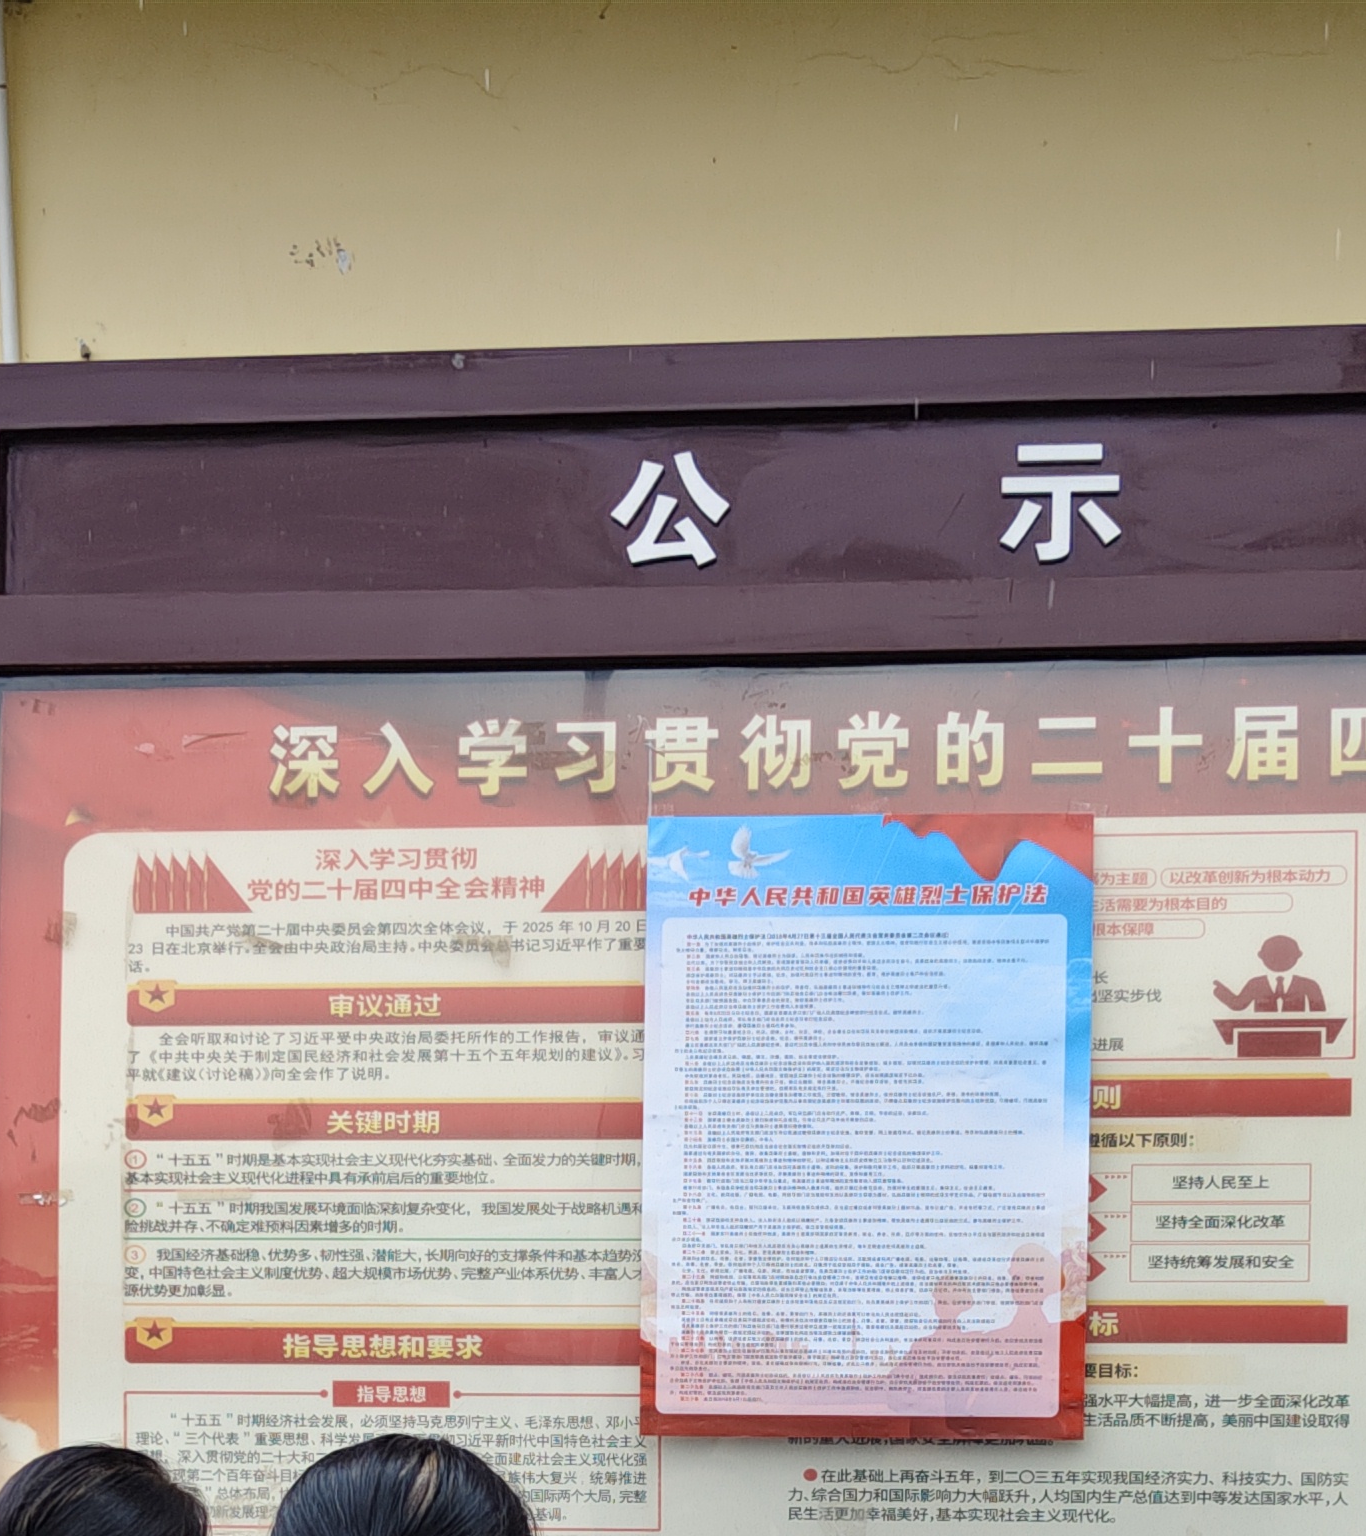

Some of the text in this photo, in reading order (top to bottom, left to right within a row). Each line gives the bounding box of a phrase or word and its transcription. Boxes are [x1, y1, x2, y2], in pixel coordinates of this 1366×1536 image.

[315, 847, 478, 873] 深入学习贯彻
[1170, 868, 1332, 885] 以改革创新为根本动力
[247, 876, 546, 902] 党的二十届四中全会精神
[687, 882, 1049, 909] 中华人民共和国英雄烈士保护法
[127, 958, 151, 975] 话。
[328, 990, 443, 1019] 审议通过
[1092, 1034, 1124, 1052] 进展
[1092, 1083, 1122, 1110] 则
[326, 1109, 441, 1136] 关键时期
[125, 1170, 496, 1187] 基本实现社会主义现代化进程中具有承前启后的重要地位。
[1171, 1174, 1271, 1191] 坚持人民至上
[125, 1219, 404, 1235] 险挑战并存、不确定难预料因素增多的时期。
[1154, 1213, 1287, 1230] 坚持全面深化改革
[1146, 1253, 1296, 1270] 坚持统筹发展和安全
[124, 1283, 232, 1299] 源优势更加彰显。
[1088, 1309, 1120, 1338] 标
[282, 1332, 484, 1361] 指导思想和要求
[356, 1384, 427, 1404] 指导思想
